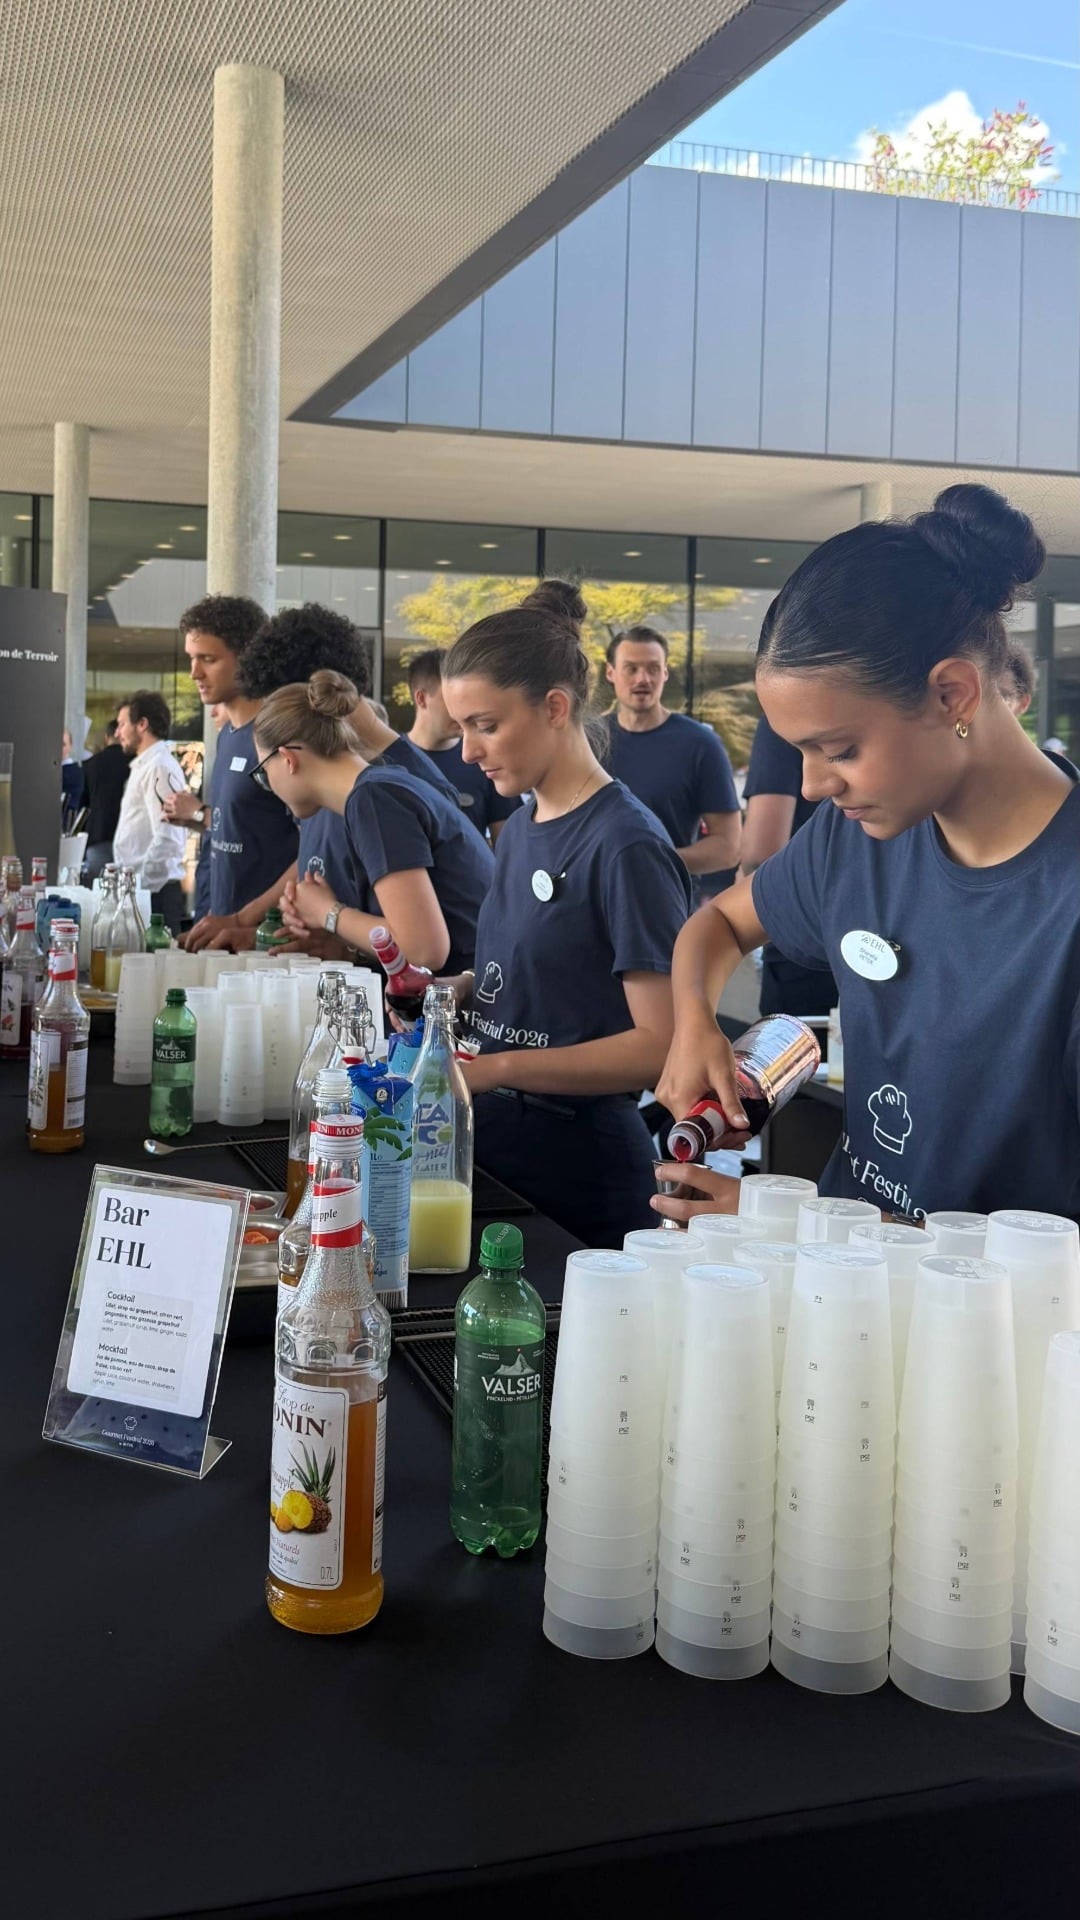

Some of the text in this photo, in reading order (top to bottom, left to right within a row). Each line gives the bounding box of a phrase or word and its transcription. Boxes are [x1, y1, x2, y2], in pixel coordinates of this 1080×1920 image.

[11, 648, 23, 660] de
[24, 649, 59, 662] Terroir
[504, 1027, 549, 1048] 2026
[155, 1049, 187, 1060] VALSER
[860, 1159, 912, 1214] Festi
[103, 1197, 150, 1226] Bar
[96, 1236, 152, 1269] EHL
[107, 1290, 136, 1303] Cocktail
[98, 1343, 128, 1355] Mocktail
[481, 1373, 542, 1395] VALSER
[300, 1402, 315, 1413] de
[274, 1402, 327, 1438] ONIN
